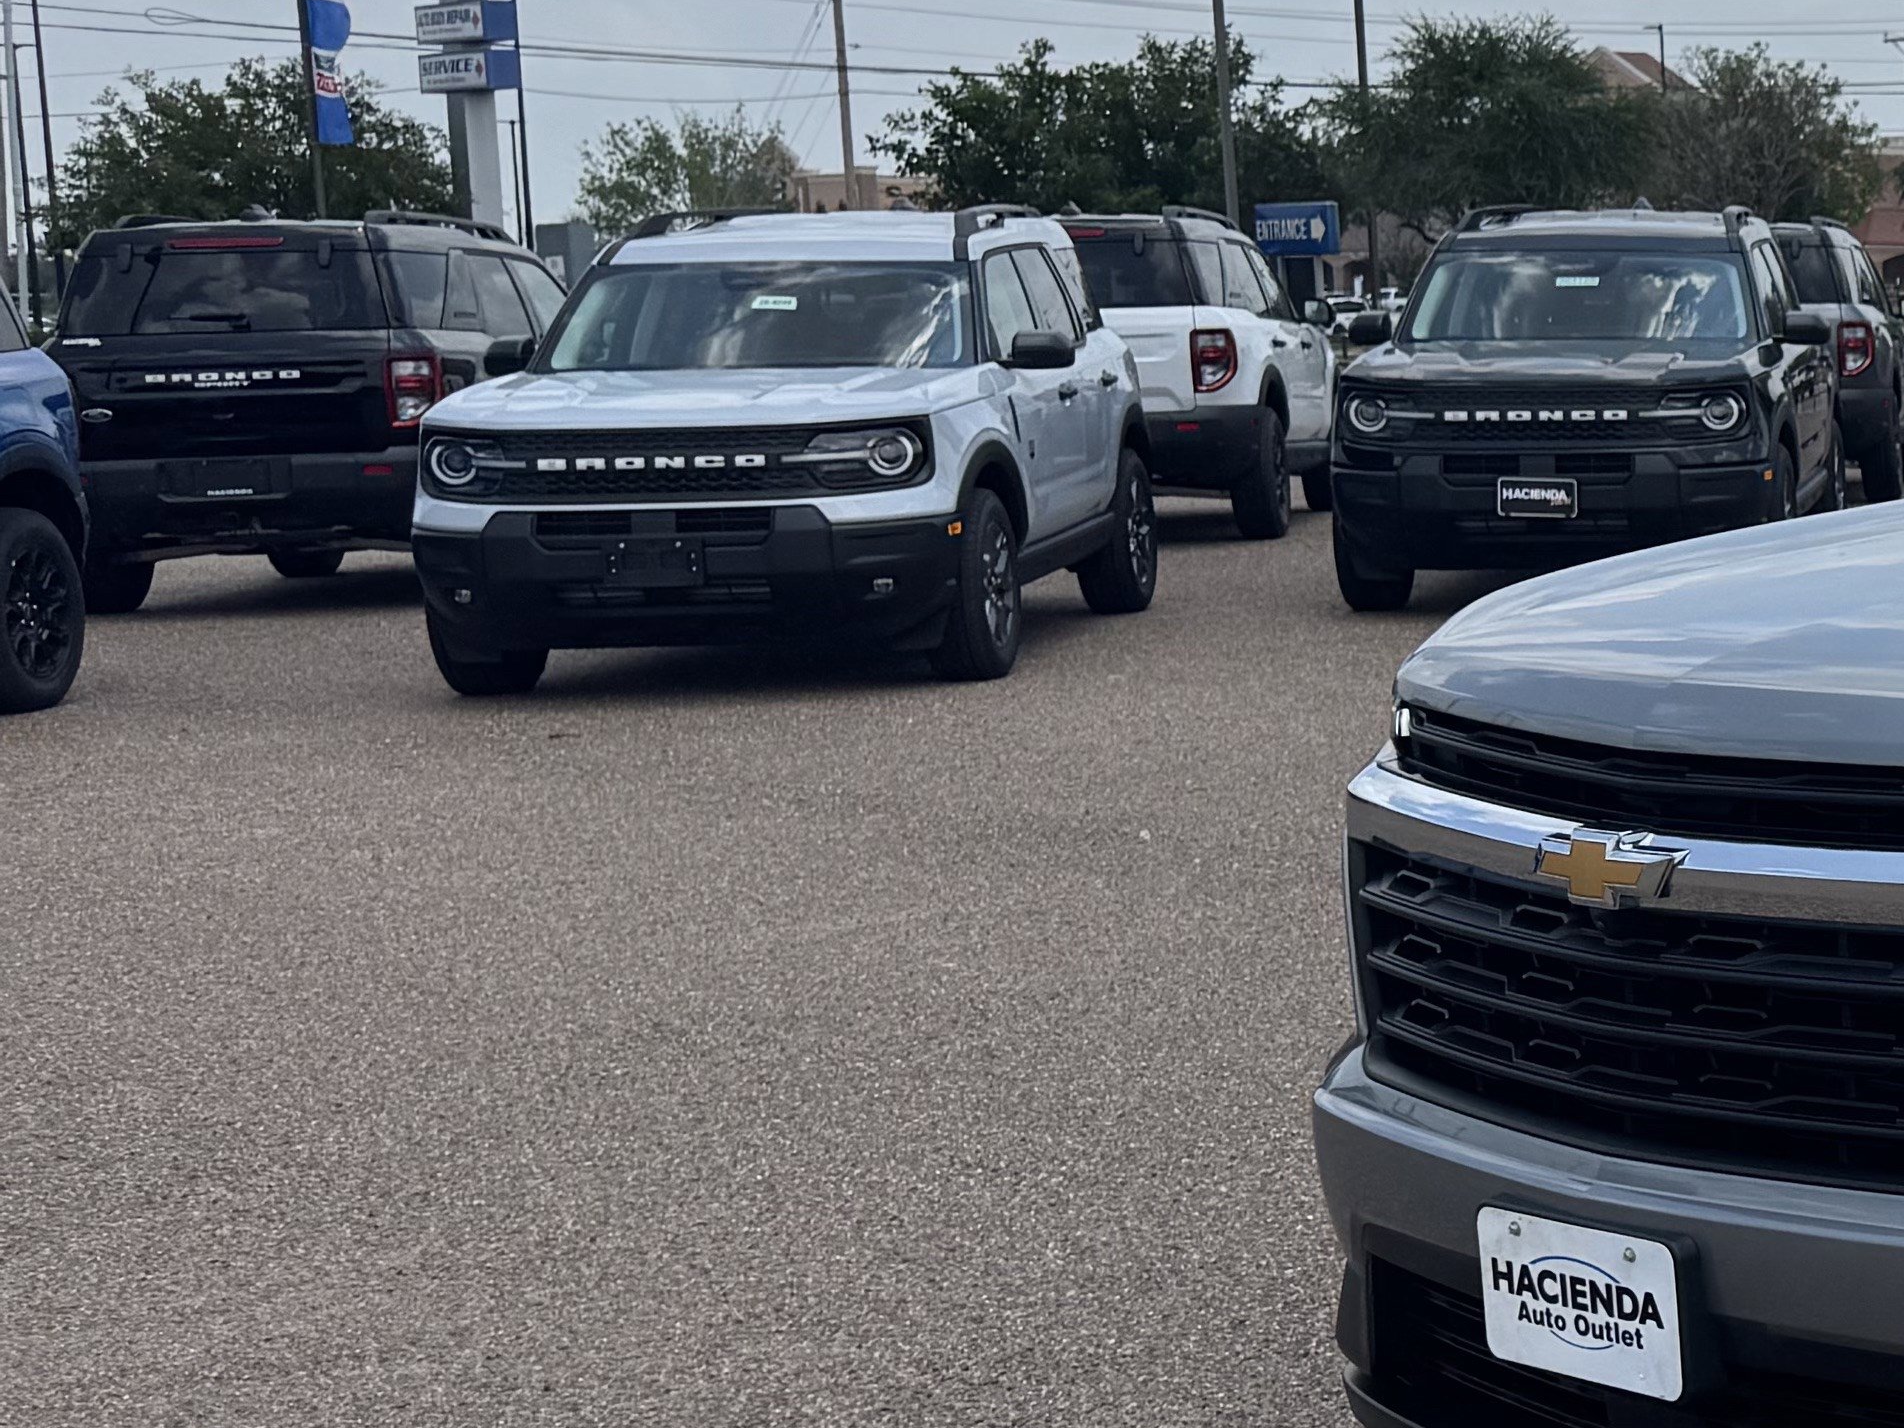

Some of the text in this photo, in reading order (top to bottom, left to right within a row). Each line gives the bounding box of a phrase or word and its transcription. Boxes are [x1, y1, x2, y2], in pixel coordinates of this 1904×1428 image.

[422, 57, 474, 76] SERVICE
[1256, 218, 1308, 241] ENTRANCE
[145, 370, 300, 383] BRONCO
[1444, 410, 1628, 421] BRONCO
[537, 454, 766, 471] BRONCO
[1502, 487, 1568, 501] HACIENDA
[1491, 1257, 1665, 1330] HACIENDA
[1518, 1300, 1645, 1350] Auto Outlet
